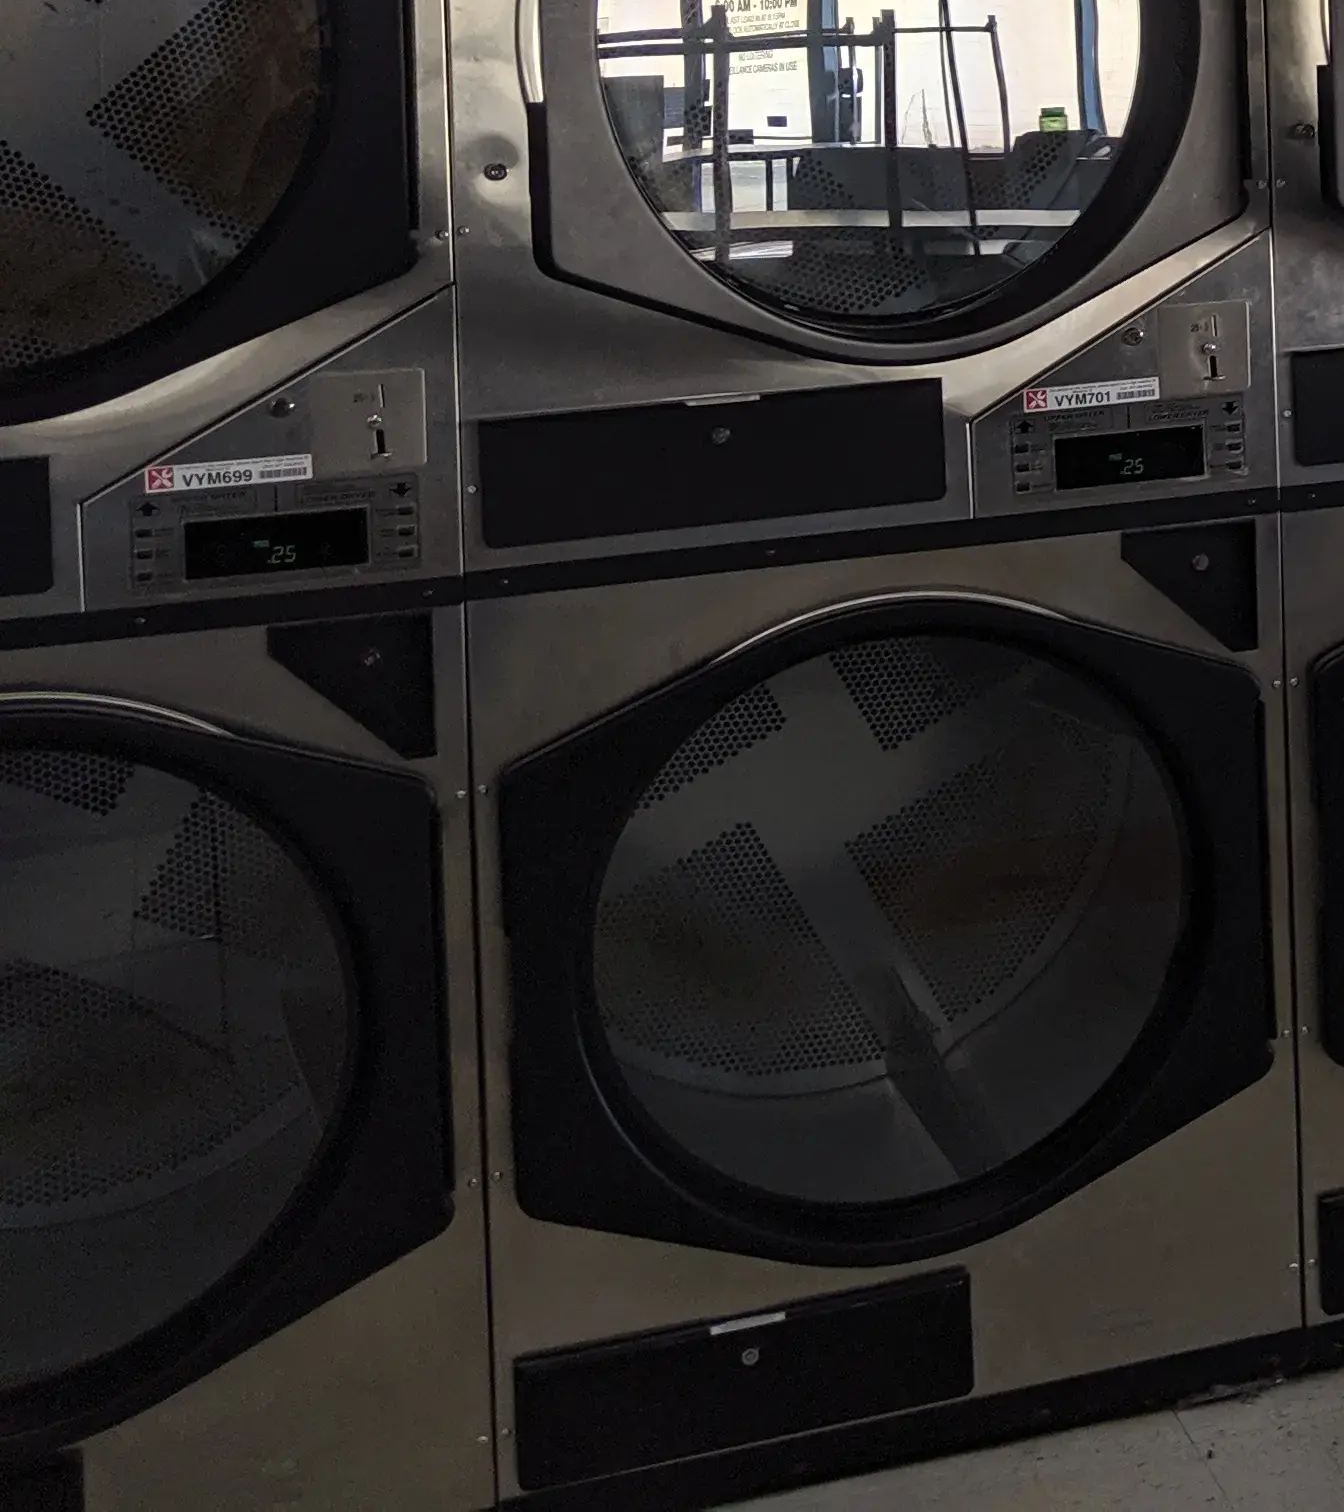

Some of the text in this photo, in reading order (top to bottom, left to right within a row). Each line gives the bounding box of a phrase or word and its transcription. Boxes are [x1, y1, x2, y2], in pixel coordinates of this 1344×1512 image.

[737, 0, 751, 12] AM
[1054, 391, 1111, 407] VYM701
[182, 470, 253, 487] VYM699
